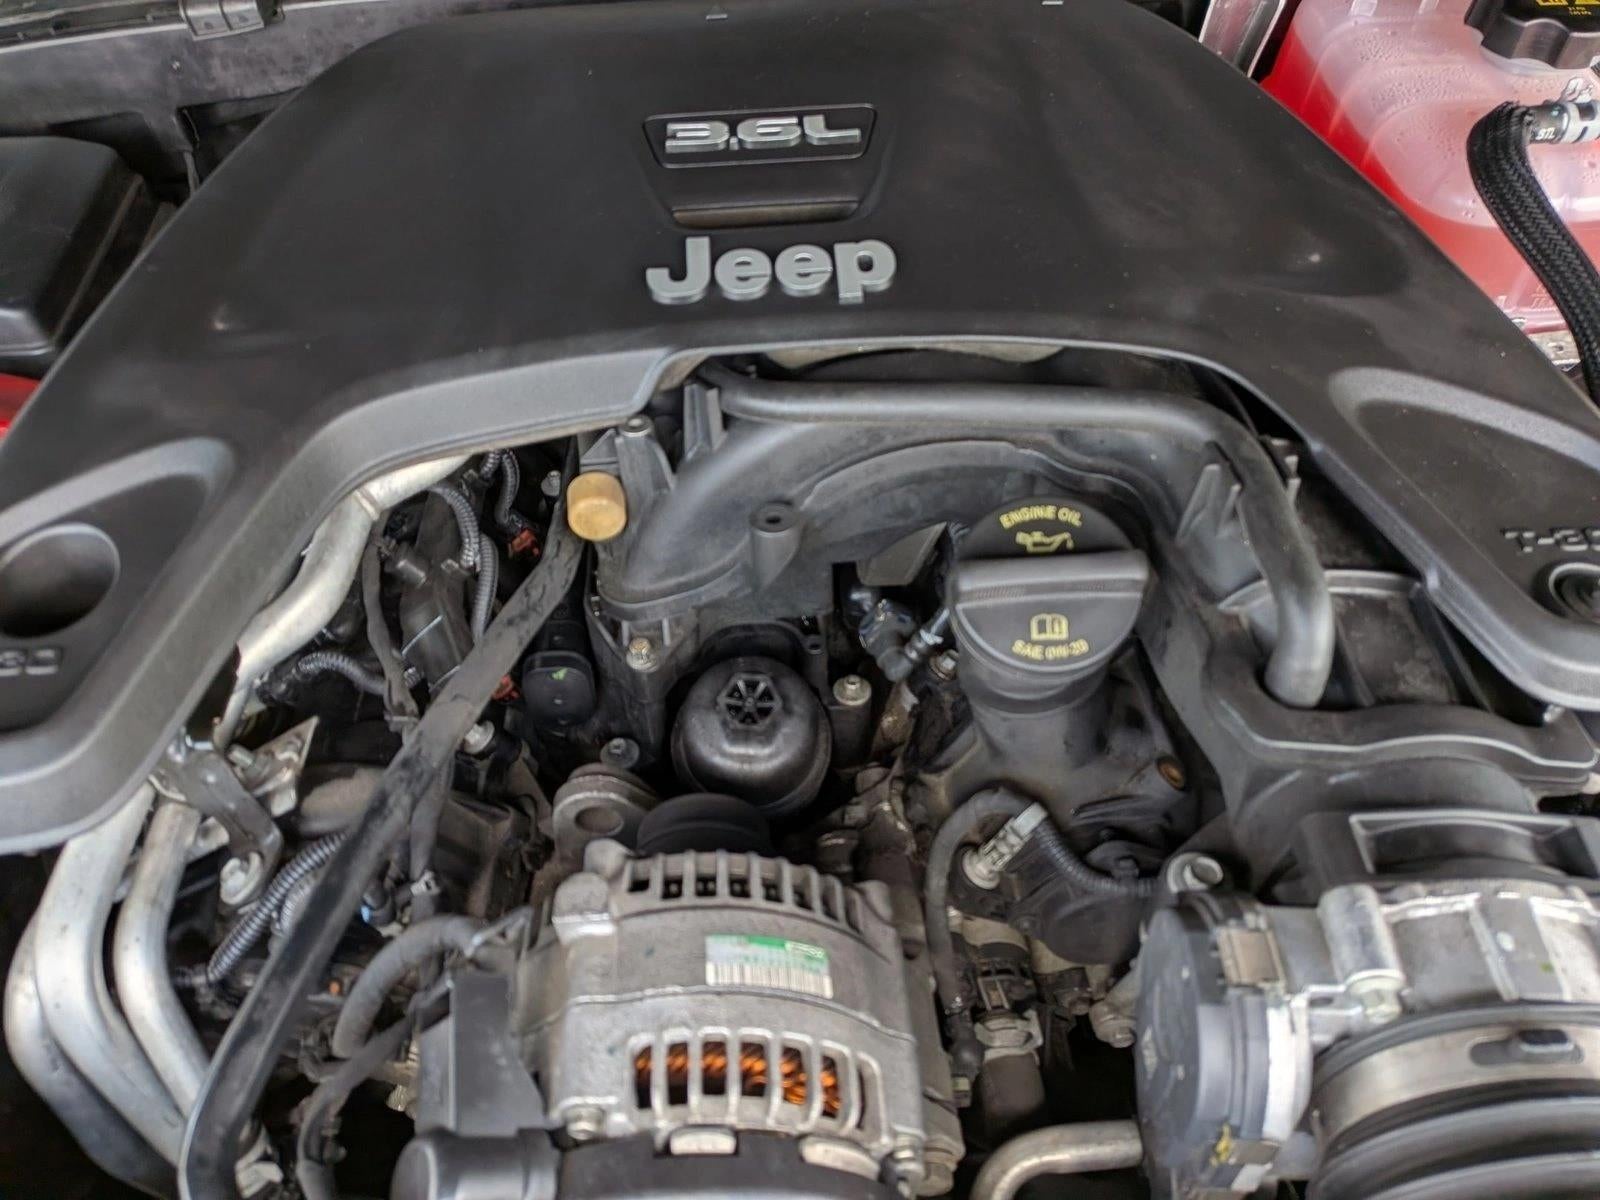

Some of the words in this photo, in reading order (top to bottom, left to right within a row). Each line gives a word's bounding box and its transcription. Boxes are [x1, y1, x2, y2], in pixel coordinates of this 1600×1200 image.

[665, 114, 862, 154] 3.6L
[645, 235, 898, 305] Jeep
[1000, 504, 1057, 529] ENGINE
[1057, 507, 1083, 528] OIL
[1012, 639, 1044, 661] SAE
